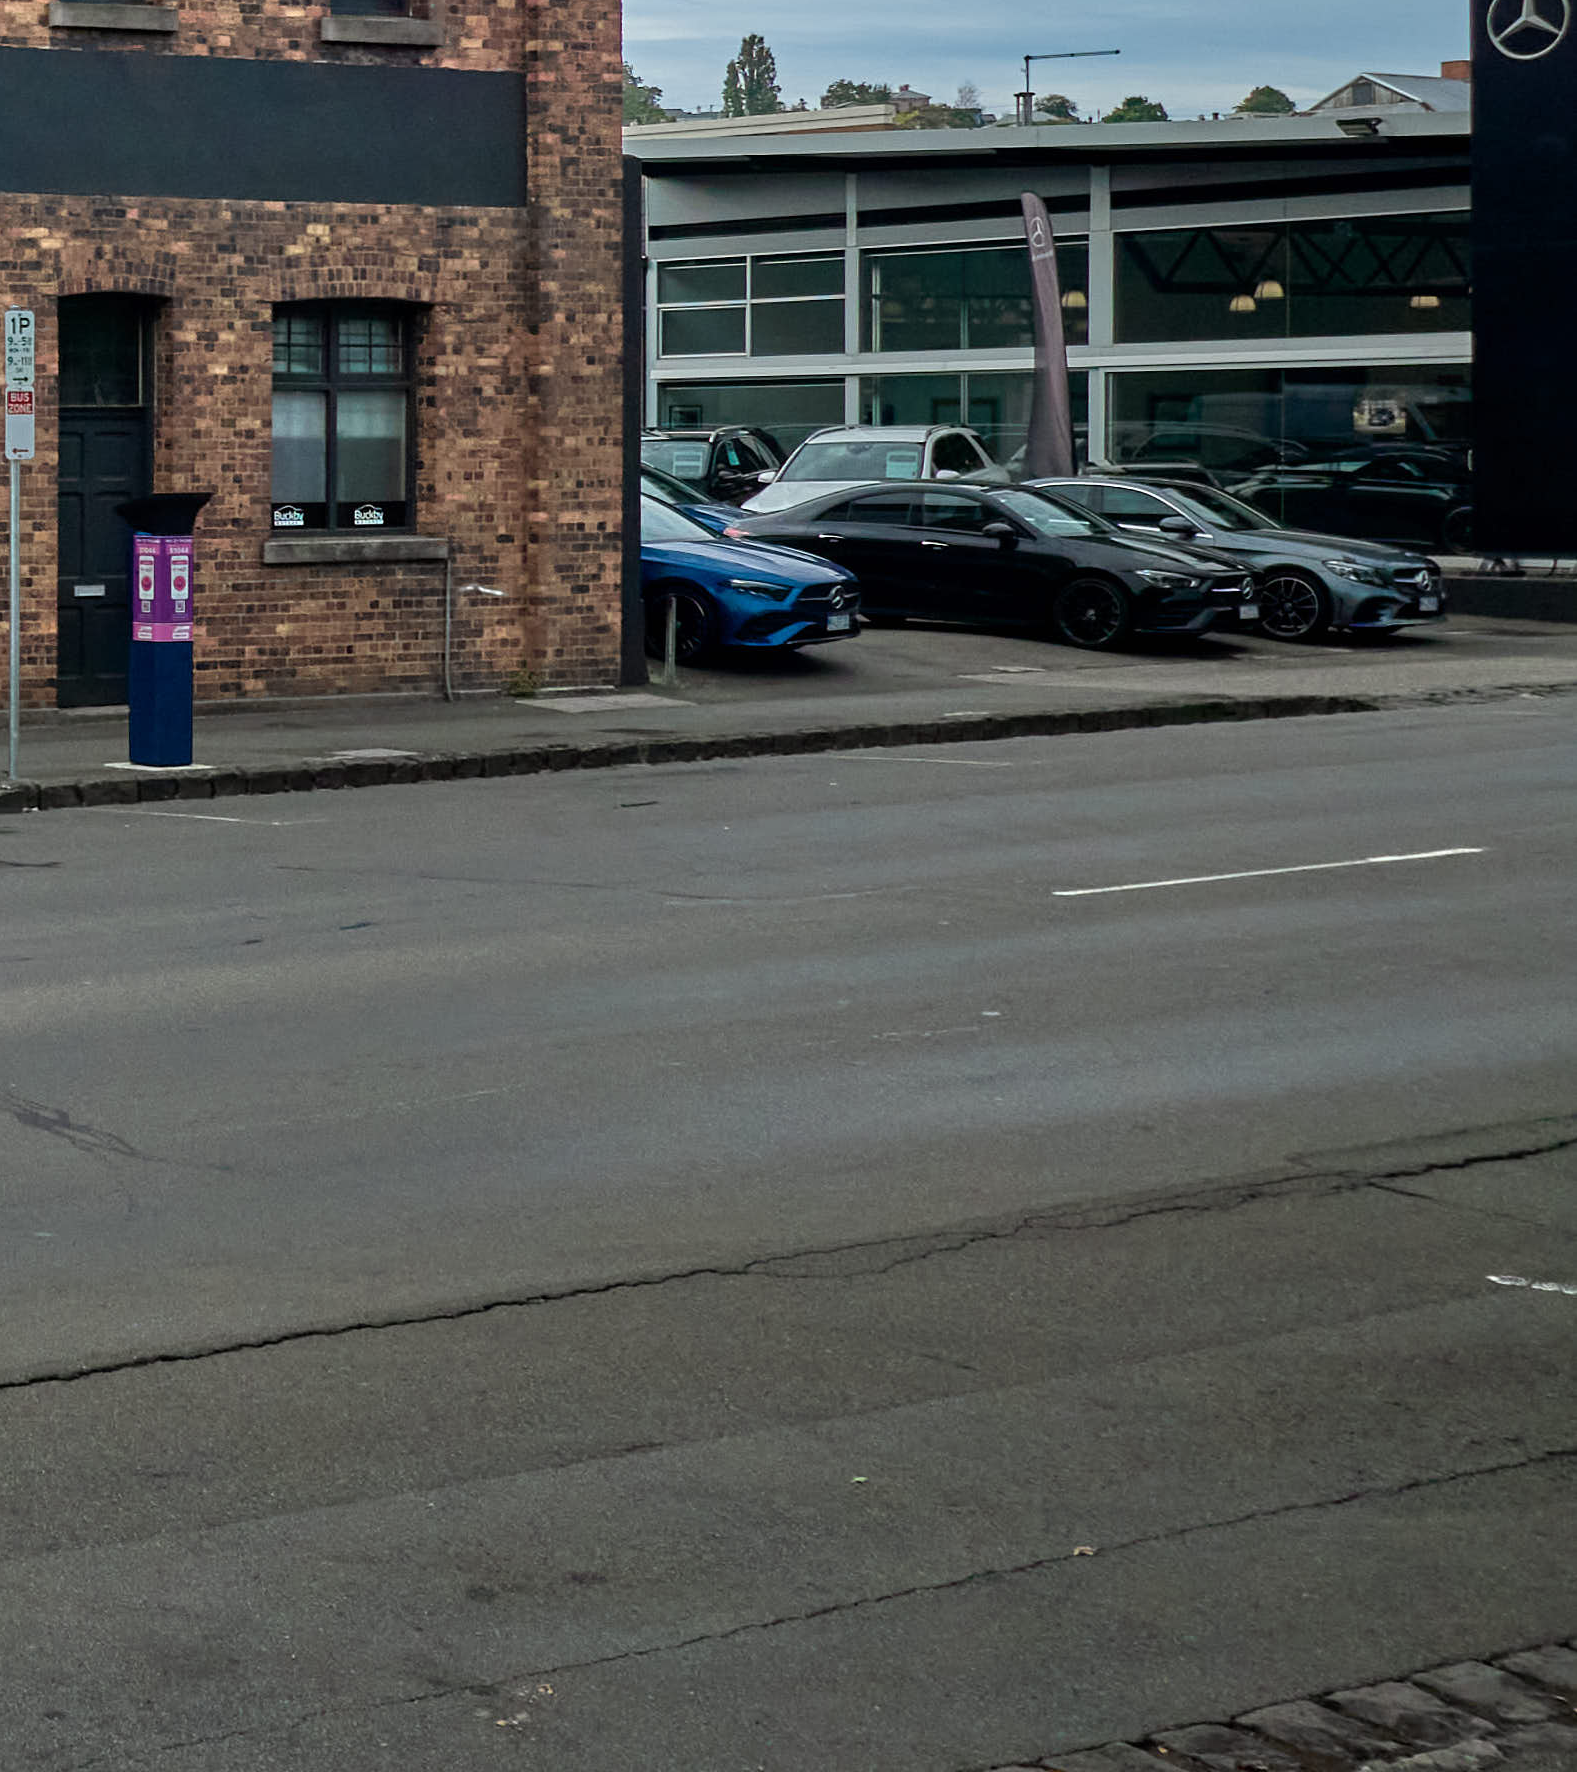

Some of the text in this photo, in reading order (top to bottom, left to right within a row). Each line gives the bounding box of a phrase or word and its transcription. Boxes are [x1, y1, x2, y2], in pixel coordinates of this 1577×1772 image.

[11, 317, 30, 334] 1P
[10, 393, 30, 402] BUS
[8, 403, 32, 413] ZONE
